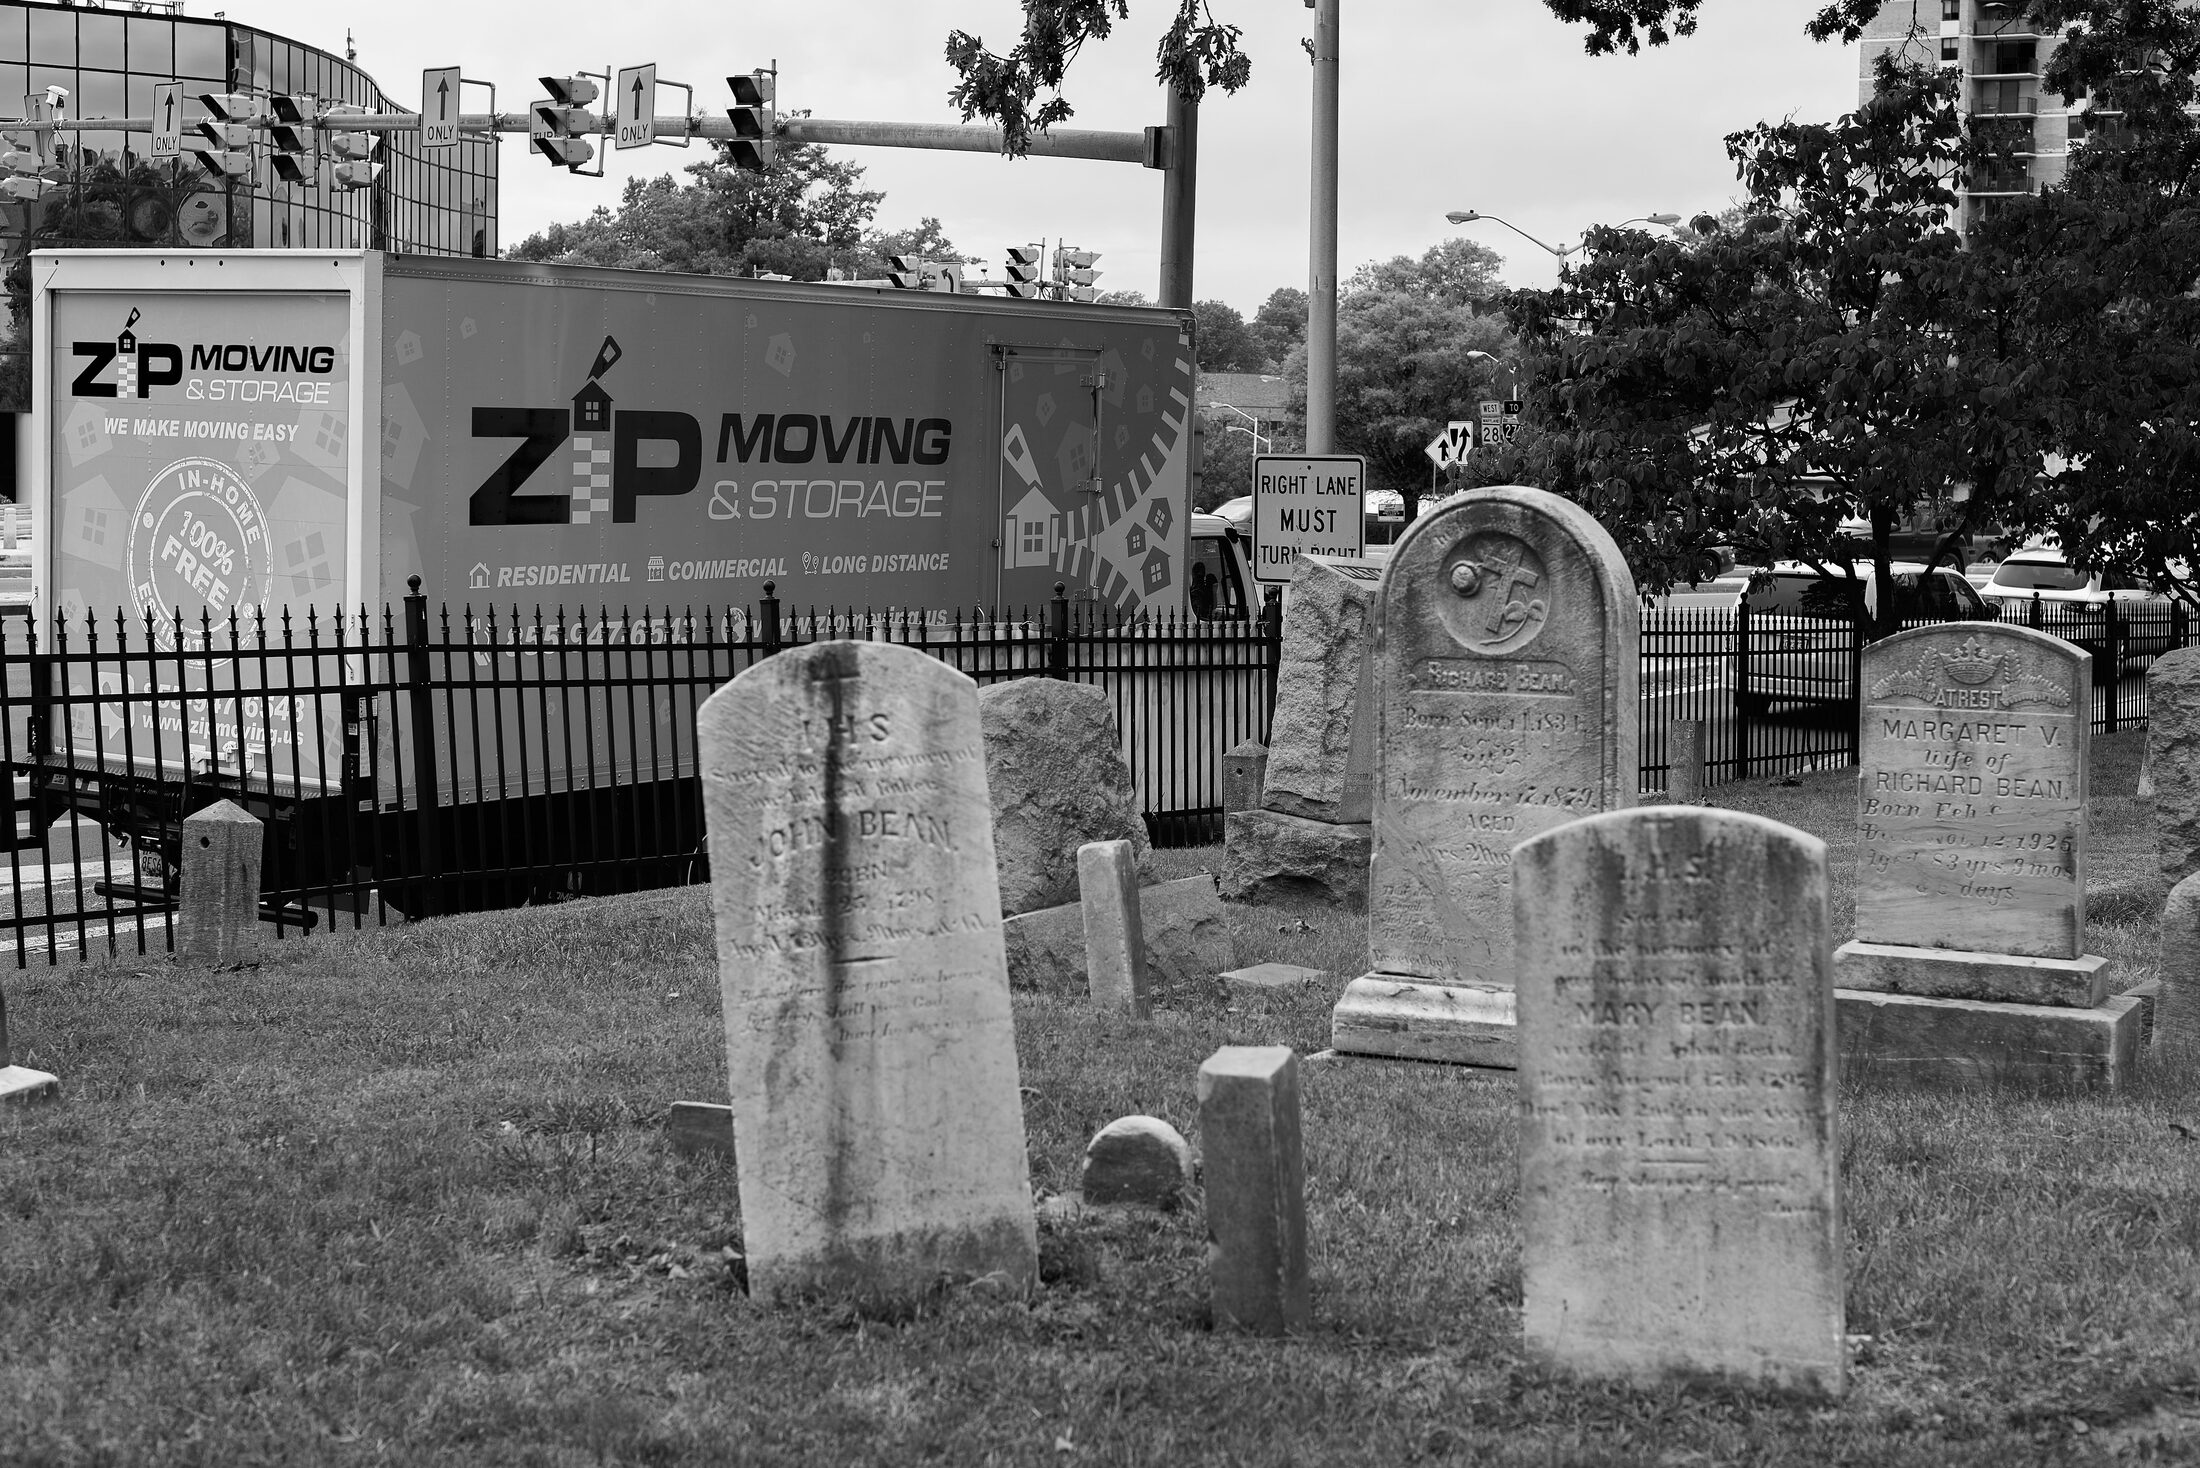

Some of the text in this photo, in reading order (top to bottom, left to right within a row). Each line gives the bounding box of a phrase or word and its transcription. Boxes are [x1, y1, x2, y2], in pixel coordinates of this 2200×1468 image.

[155, 136, 178, 151] ONLY
[427, 125, 454, 141] ONLY
[622, 123, 650, 142] ONLY
[190, 343, 335, 374] MOVING
[186, 379, 332, 404] & STORAGE
[1482, 404, 1498, 413] WEST
[1509, 403, 1519, 412] TO
[104, 417, 299, 442] WE MAKE MOVING EASY
[716, 412, 952, 466] MOVING
[1483, 426, 1499, 442] 28
[1261, 475, 1357, 496] RIGHT LANE
[177, 469, 261, 545] IN-HOME
[708, 480, 946, 520] & STORAGE
[1280, 509, 1337, 533] MUST
[179, 510, 235, 576] 100%
[160, 534, 230, 612] FREE
[496, 563, 631, 588] RESIDENTIAL
[668, 557, 788, 581] COMMERCIAL
[821, 553, 950, 576] LONG DISTANCE
[1883, 719, 2063, 748] MARGARET V.
[1985, 752, 2013, 775] of
[1876, 771, 2070, 801] RICHARD BEAN.
[1863, 799, 1921, 818] Born
[1463, 812, 1515, 832] AGED
[750, 815, 838, 868] JOHN
[1574, 1001, 1661, 1027] MARY
